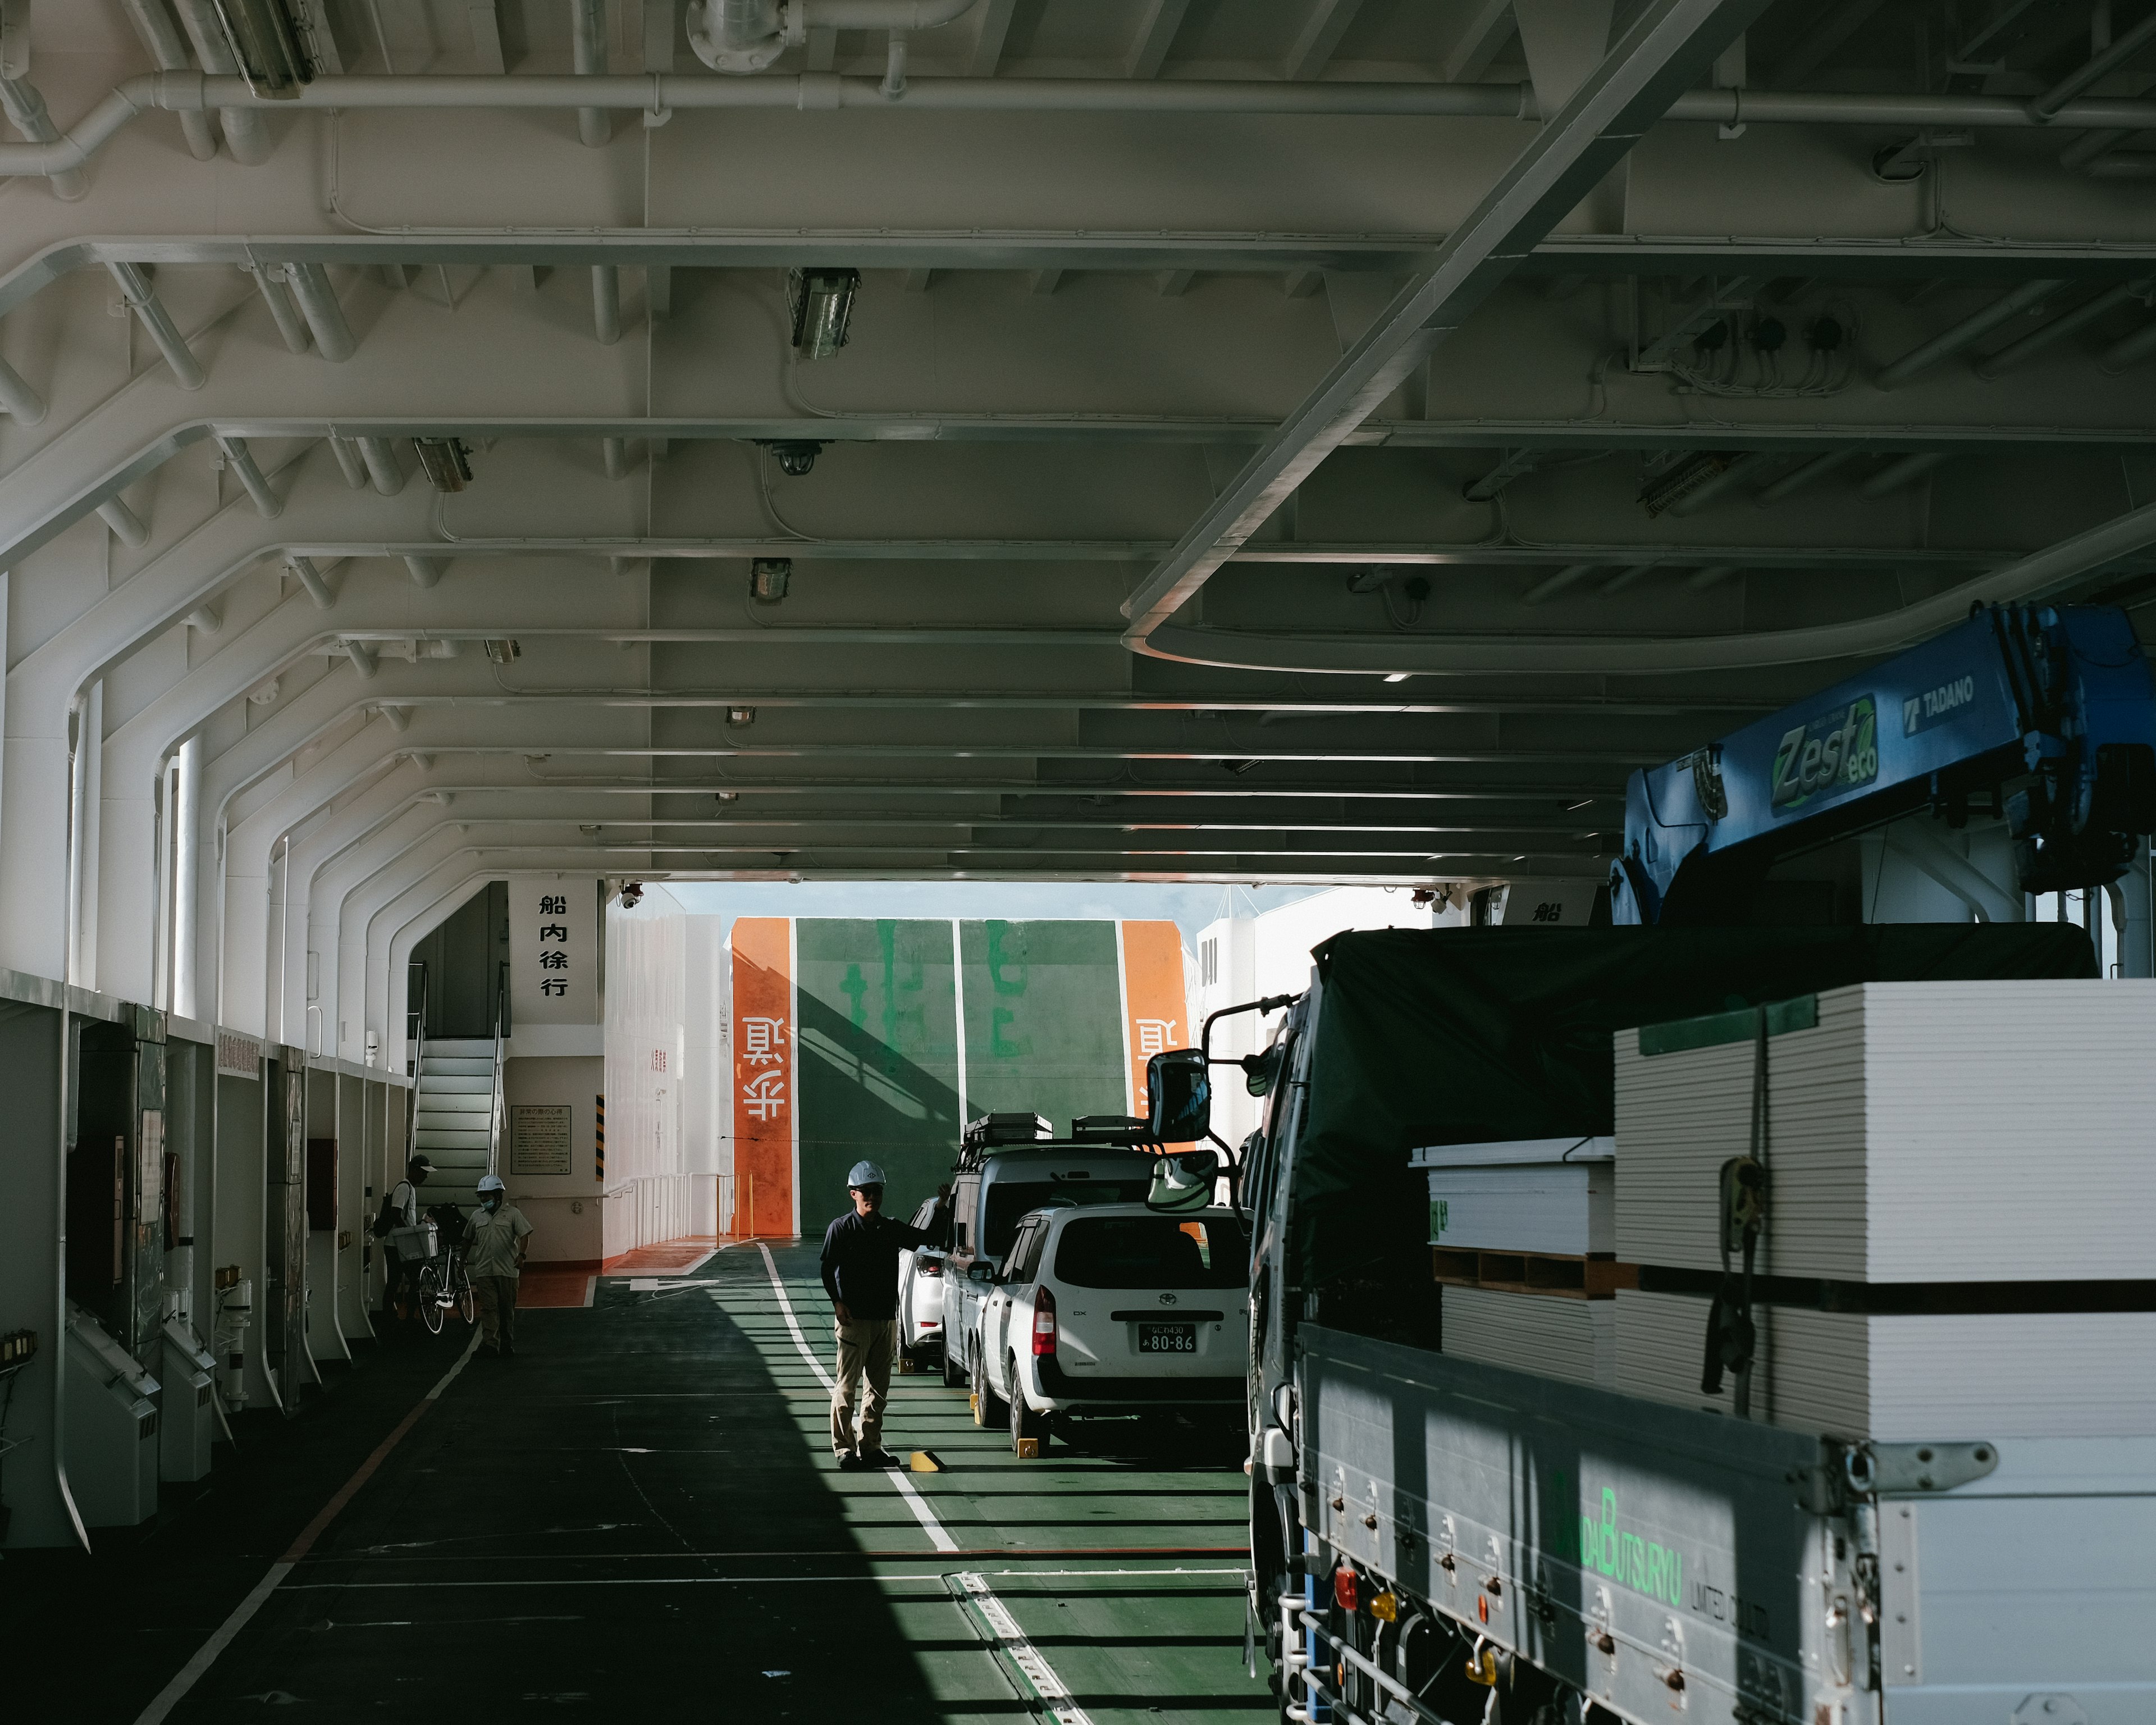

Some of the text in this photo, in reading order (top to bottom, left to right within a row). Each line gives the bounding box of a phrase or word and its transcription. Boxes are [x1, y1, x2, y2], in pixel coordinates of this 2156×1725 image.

[1923, 675, 1974, 719] TADANO
[1773, 703, 1859, 804] Zest
[1848, 747, 1876, 784] eco
[538, 895, 569, 997] 船内徐行
[1532, 902, 1562, 921] 船
[742, 1017, 785, 1121] 歩道
[1136, 1019, 1178, 1116] 道
[1152, 1335, 1193, 1350] 80-86
